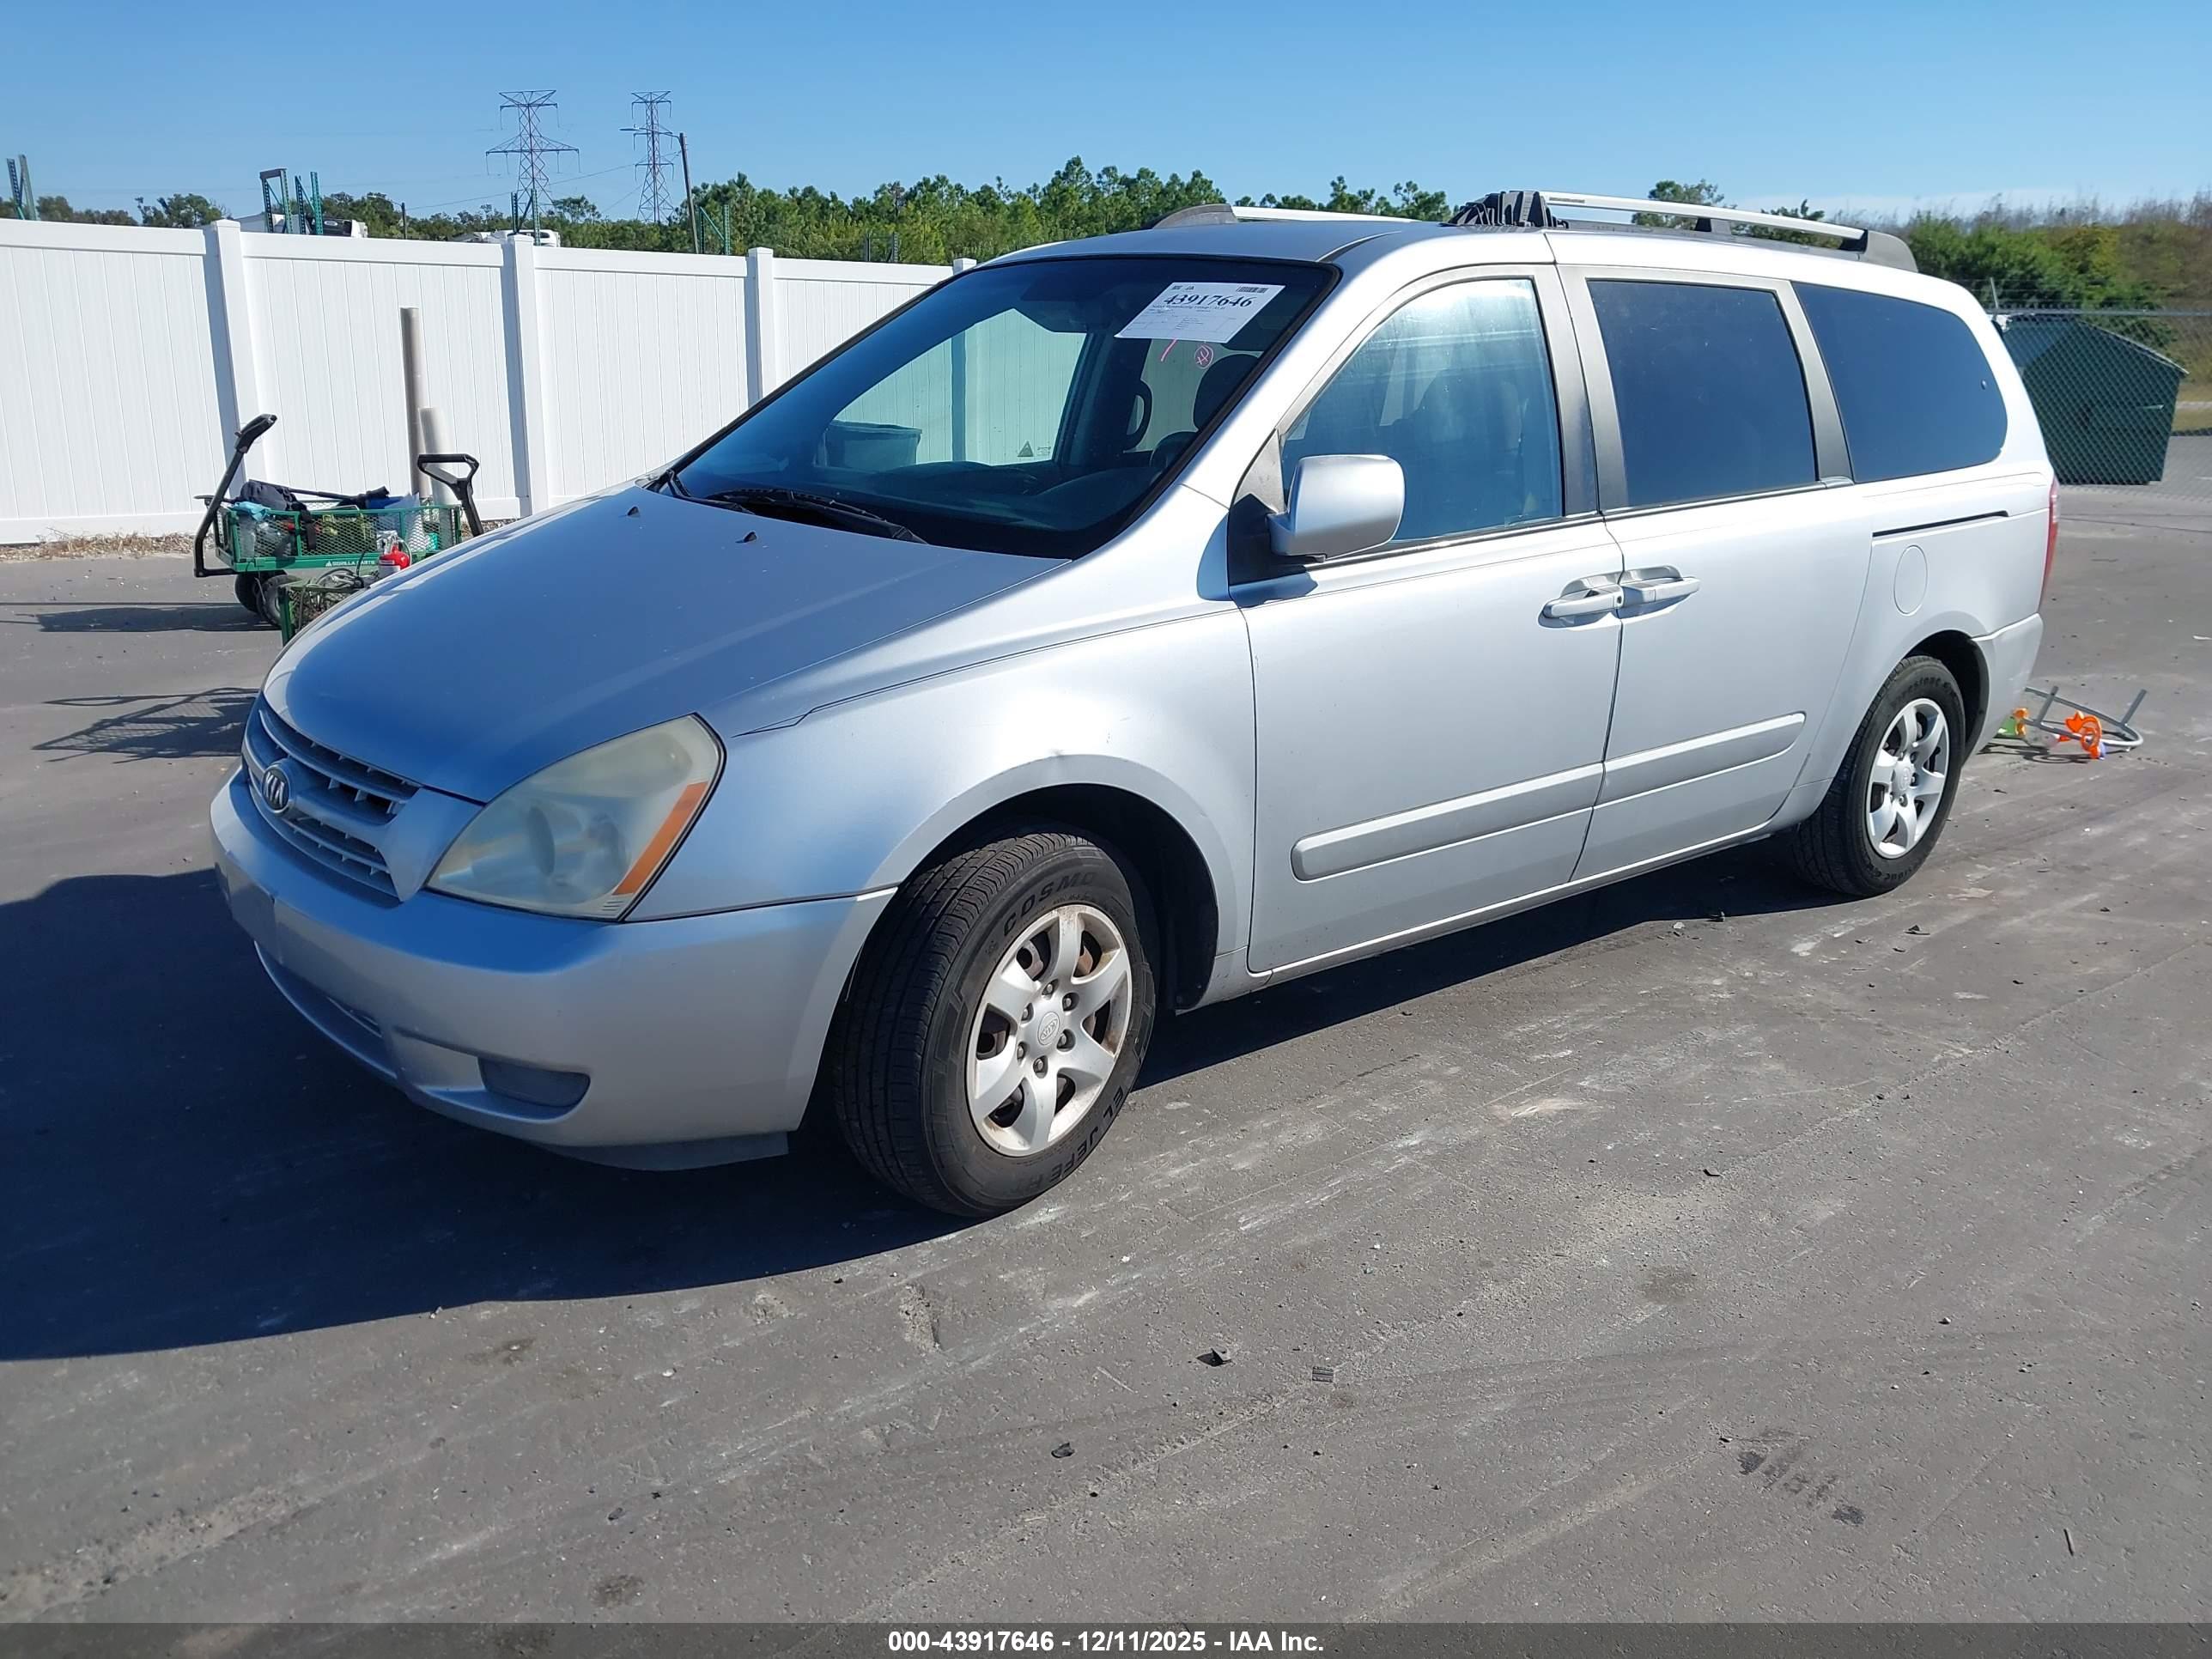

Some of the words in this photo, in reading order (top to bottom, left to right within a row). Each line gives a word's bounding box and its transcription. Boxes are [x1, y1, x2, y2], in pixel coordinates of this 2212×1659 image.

[1163, 293, 1258, 307] 43917646
[264, 771, 286, 805] KIA
[1003, 872, 1097, 937] COSMO
[1103, 1086, 1124, 1123] EL
[1048, 1125, 1100, 1183] JEFE
